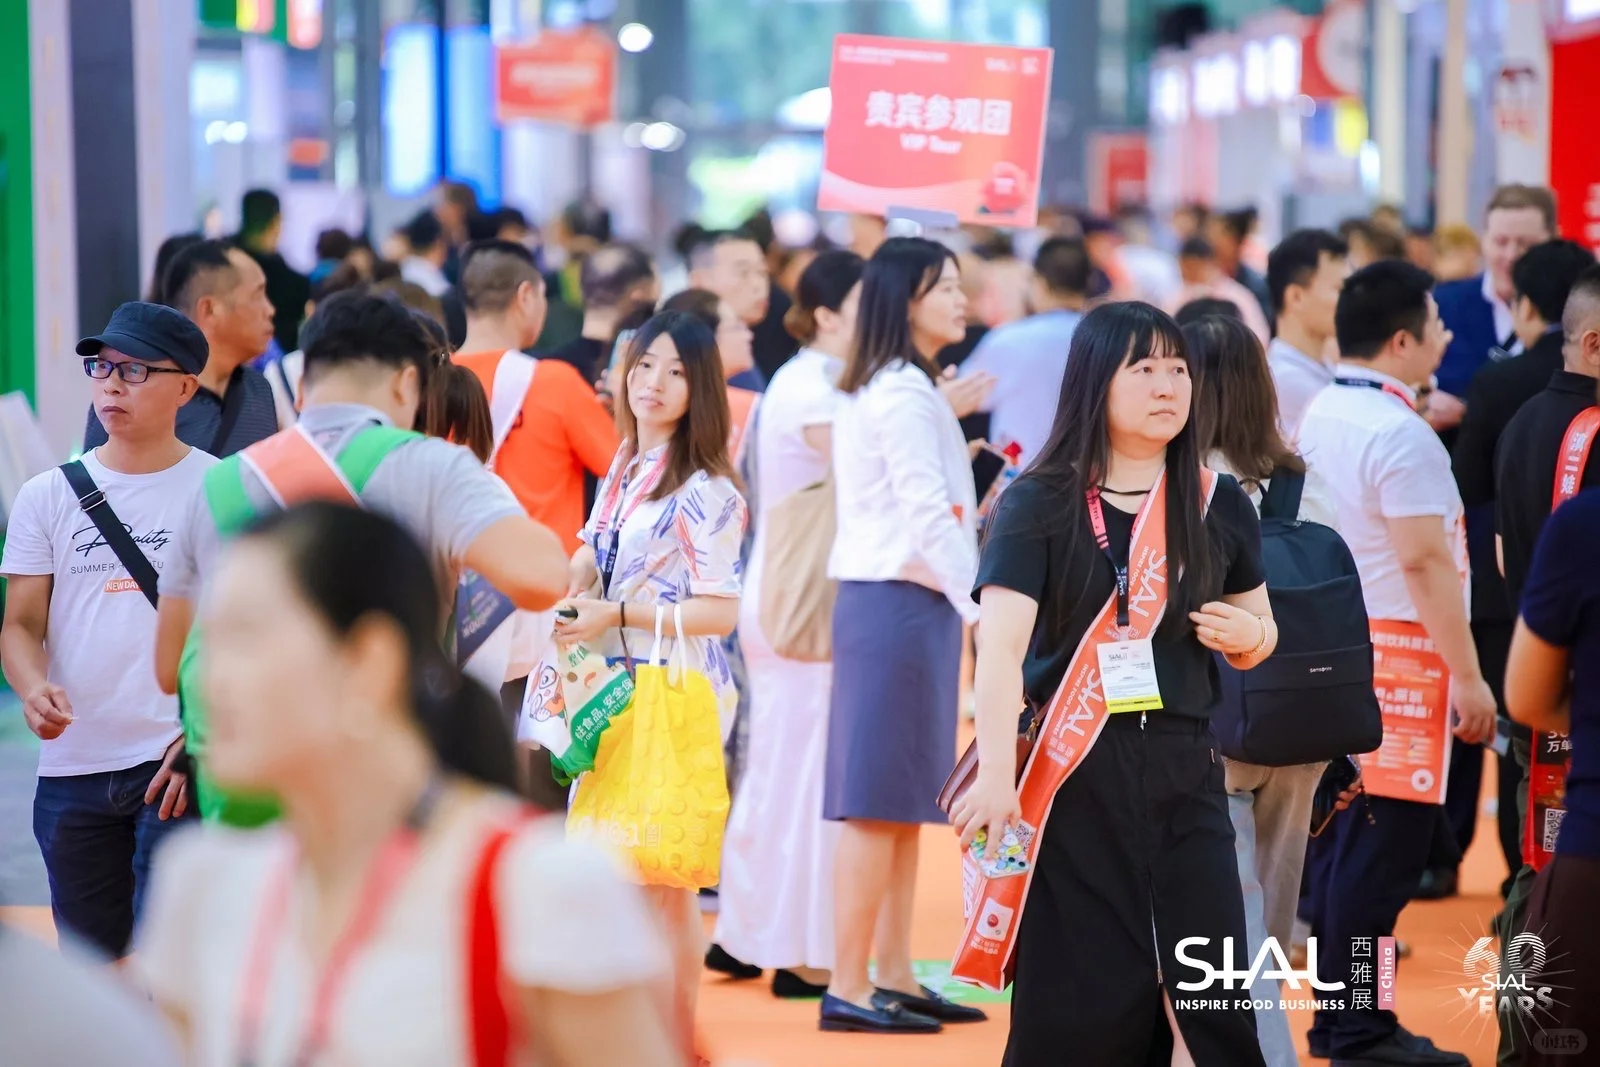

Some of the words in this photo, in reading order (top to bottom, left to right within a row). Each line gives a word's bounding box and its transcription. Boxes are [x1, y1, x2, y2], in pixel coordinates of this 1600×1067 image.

[865, 90, 1012, 135] 贵宾参观团
[900, 133, 928, 151] VIP
[71, 563, 115, 575] SUMMER
